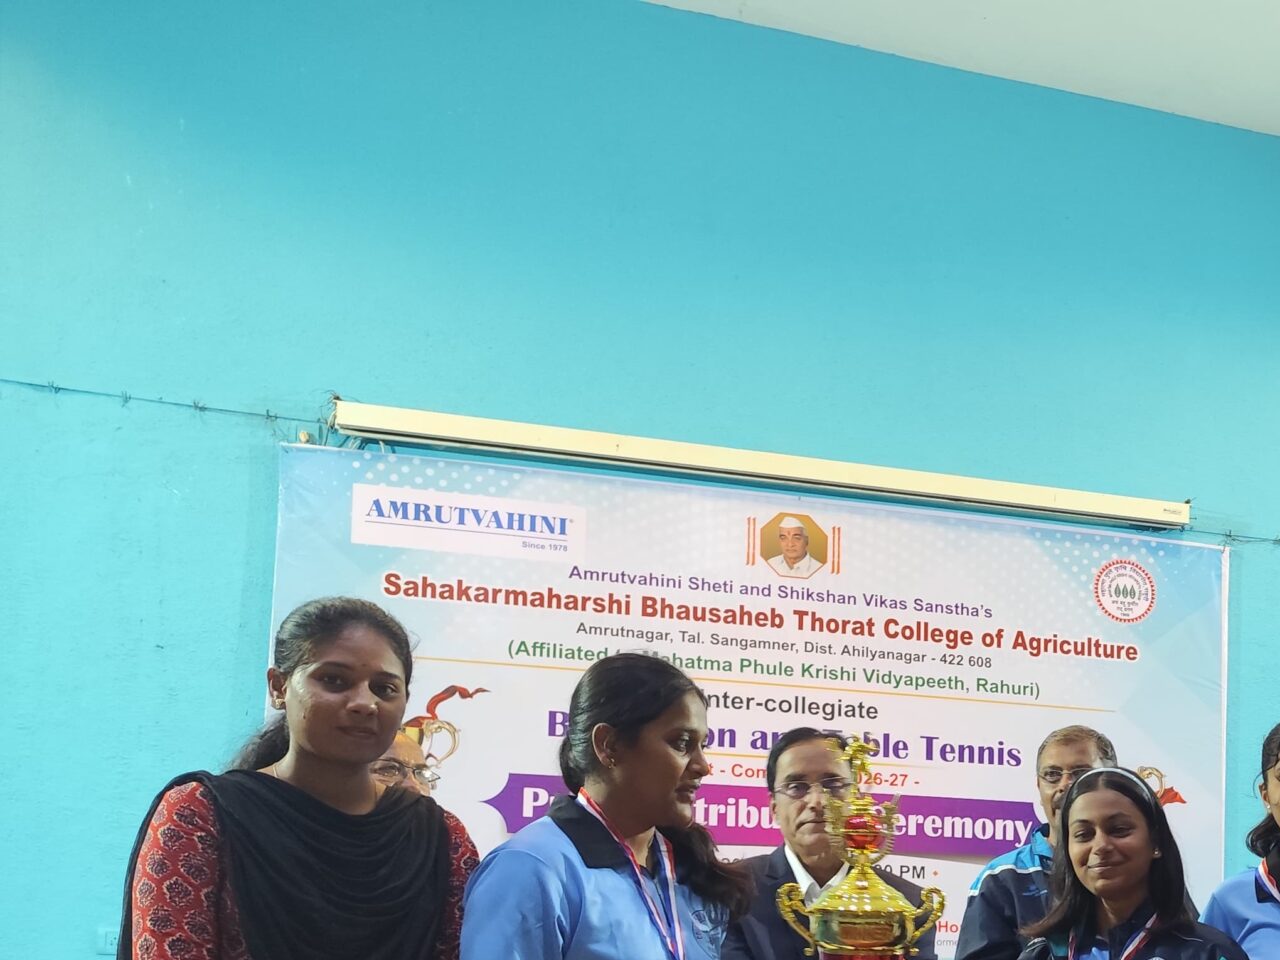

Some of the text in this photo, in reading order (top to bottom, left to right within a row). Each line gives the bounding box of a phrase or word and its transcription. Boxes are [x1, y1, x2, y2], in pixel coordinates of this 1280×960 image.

[365, 498, 568, 536] AMRUTVAHINI
[521, 541, 546, 550] Since
[568, 565, 682, 589] Amrutvahini
[688, 577, 734, 594] Sheti
[739, 584, 772, 598] and
[778, 584, 857, 605] Shikshan
[863, 593, 908, 611] Vikas
[383, 573, 1139, 661] Sahakarmaharshi Bhausaheb Thorat College of Agriculture
[576, 622, 674, 644] Amrutnagar,
[679, 630, 704, 644] Tal.
[710, 633, 799, 653] Sangamner,
[804, 640, 837, 656] Dist.
[841, 643, 927, 665] Ahilyanagar
[939, 653, 964, 666] 422
[968, 655, 992, 668] 608
[508, 639, 1041, 700] (Affiliated hatma Phule Krishi Vidyapeeth, Rahuri)
[702, 689, 879, 720] nter-collegiate
[920, 735, 1023, 767] Tennis
[900, 864, 926, 879] PM
